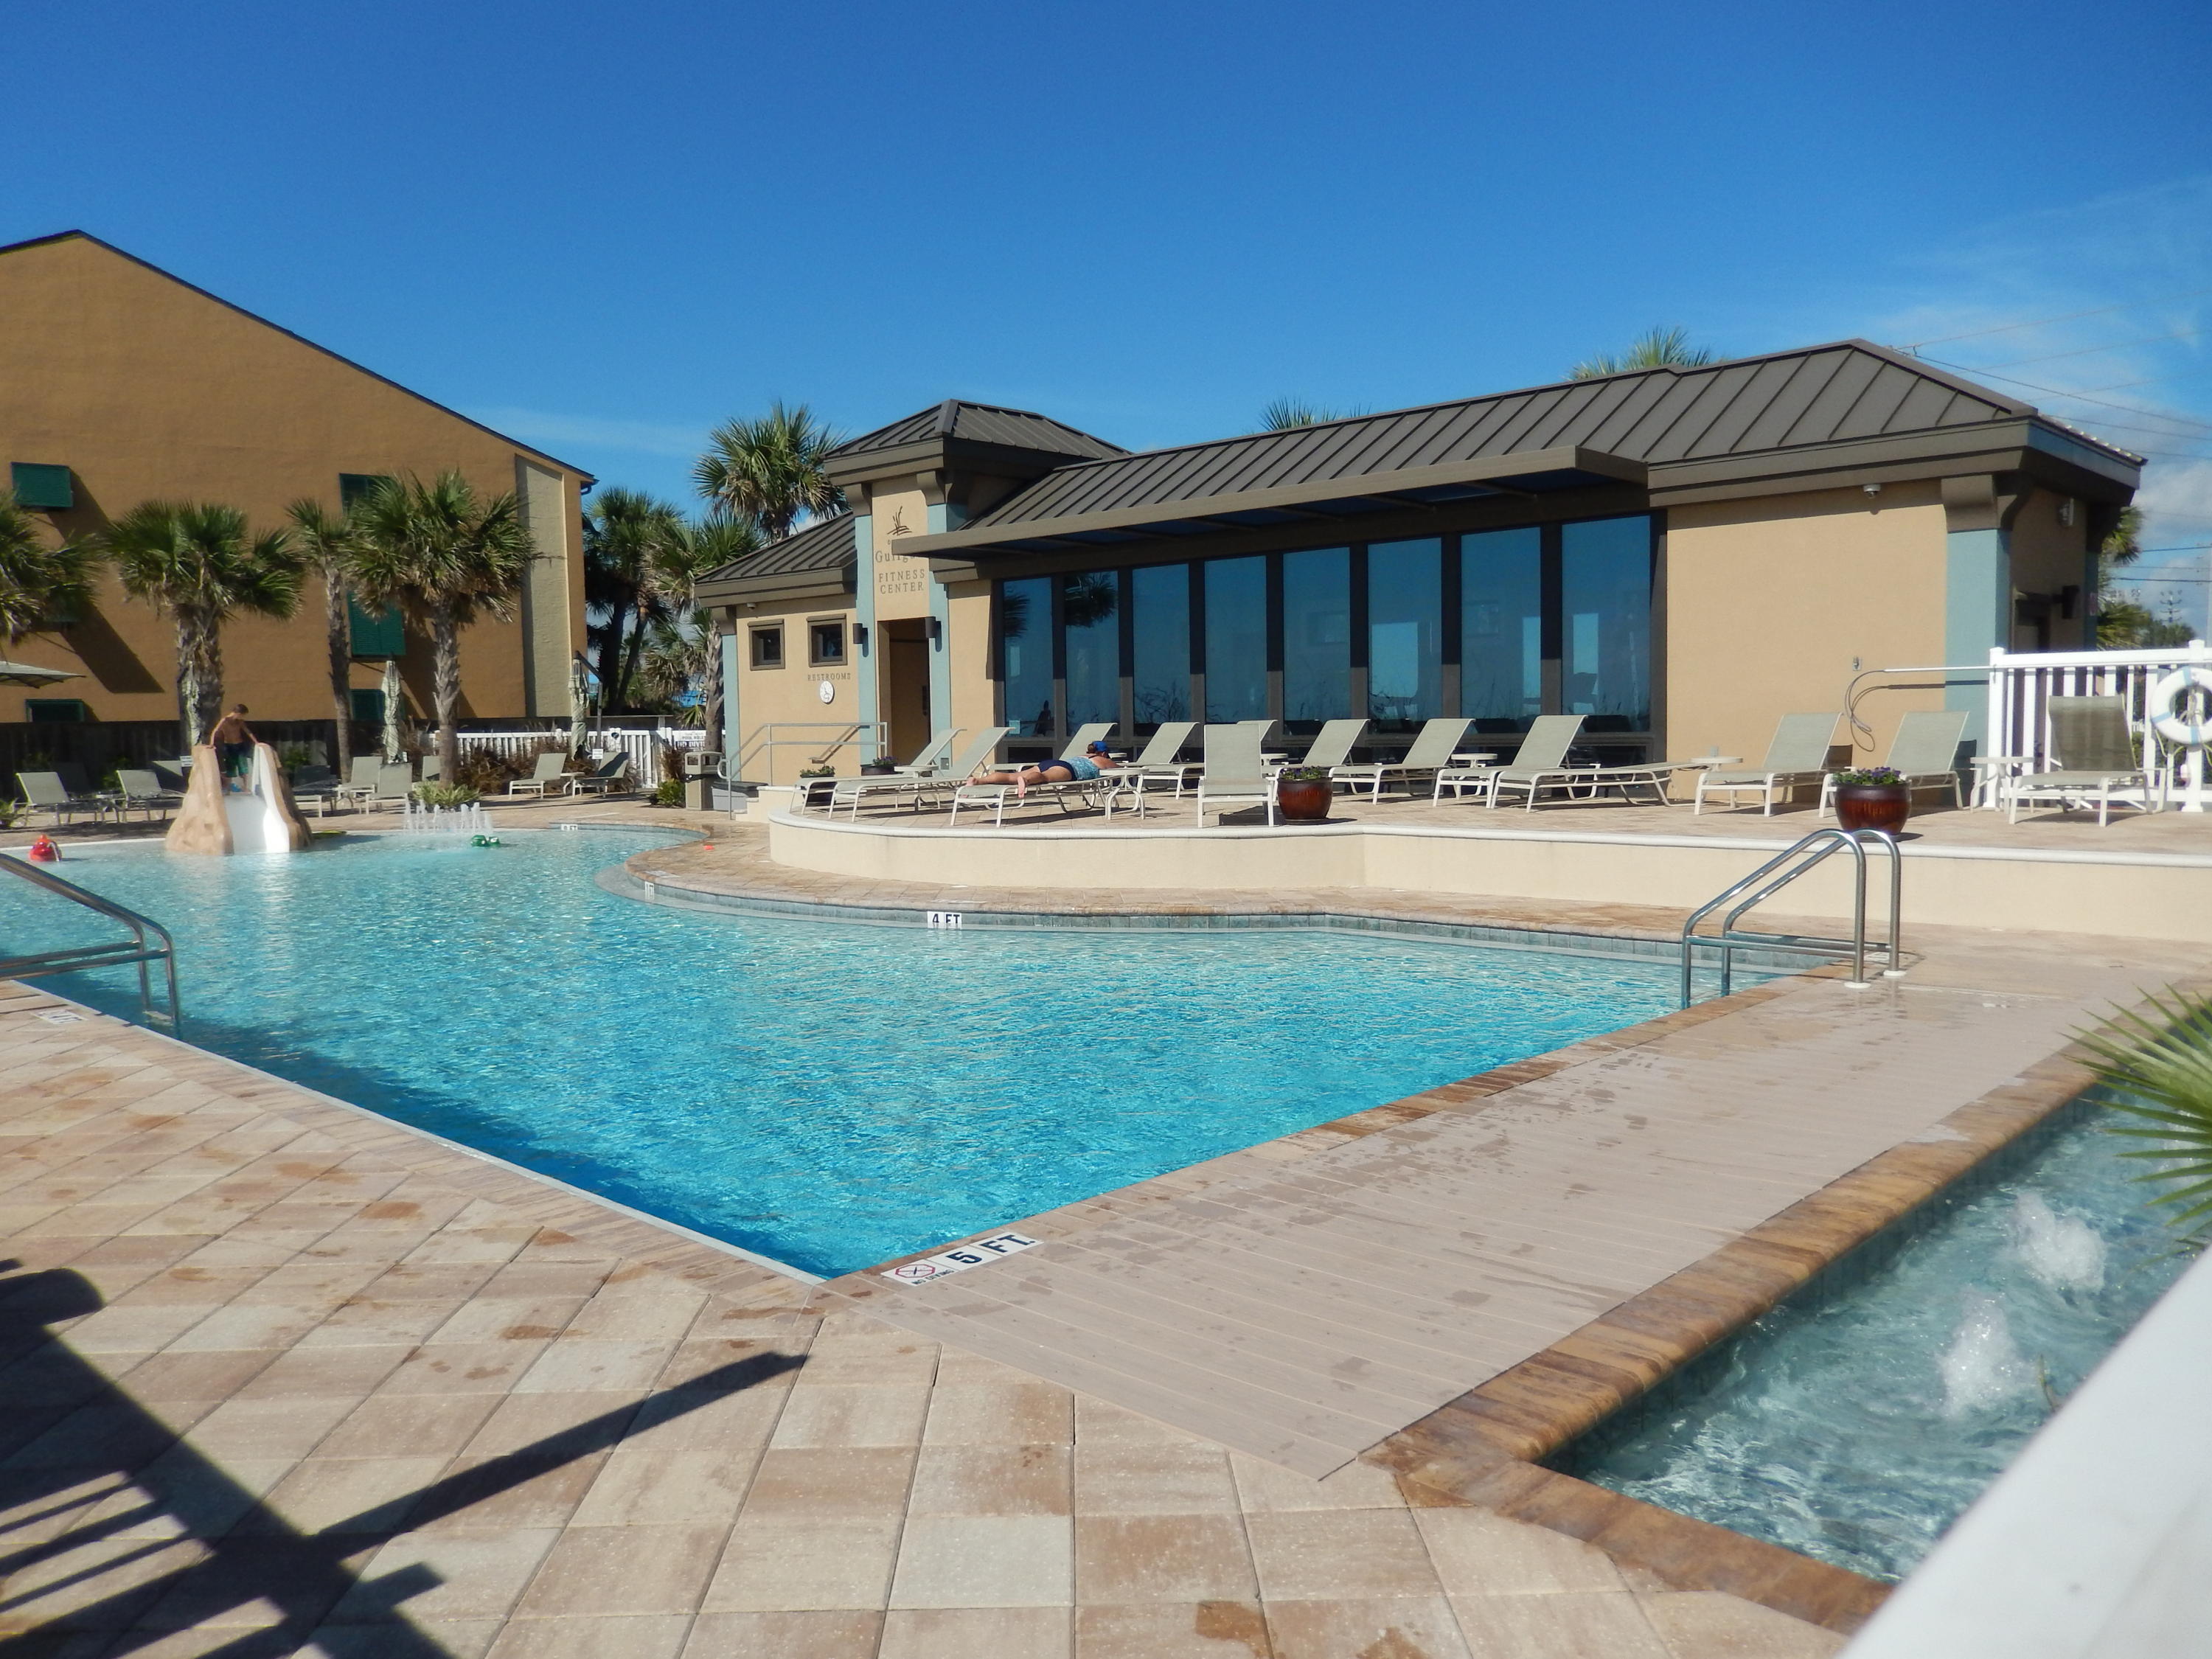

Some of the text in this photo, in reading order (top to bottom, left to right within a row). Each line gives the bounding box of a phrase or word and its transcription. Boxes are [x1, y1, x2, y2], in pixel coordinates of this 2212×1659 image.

[879, 569, 925, 582] FITNESS
[880, 582, 924, 594] CENTER
[808, 672, 851, 681] RESTROOMS
[933, 914, 960, 923] 4 FT
[945, 1251, 982, 1264] 5
